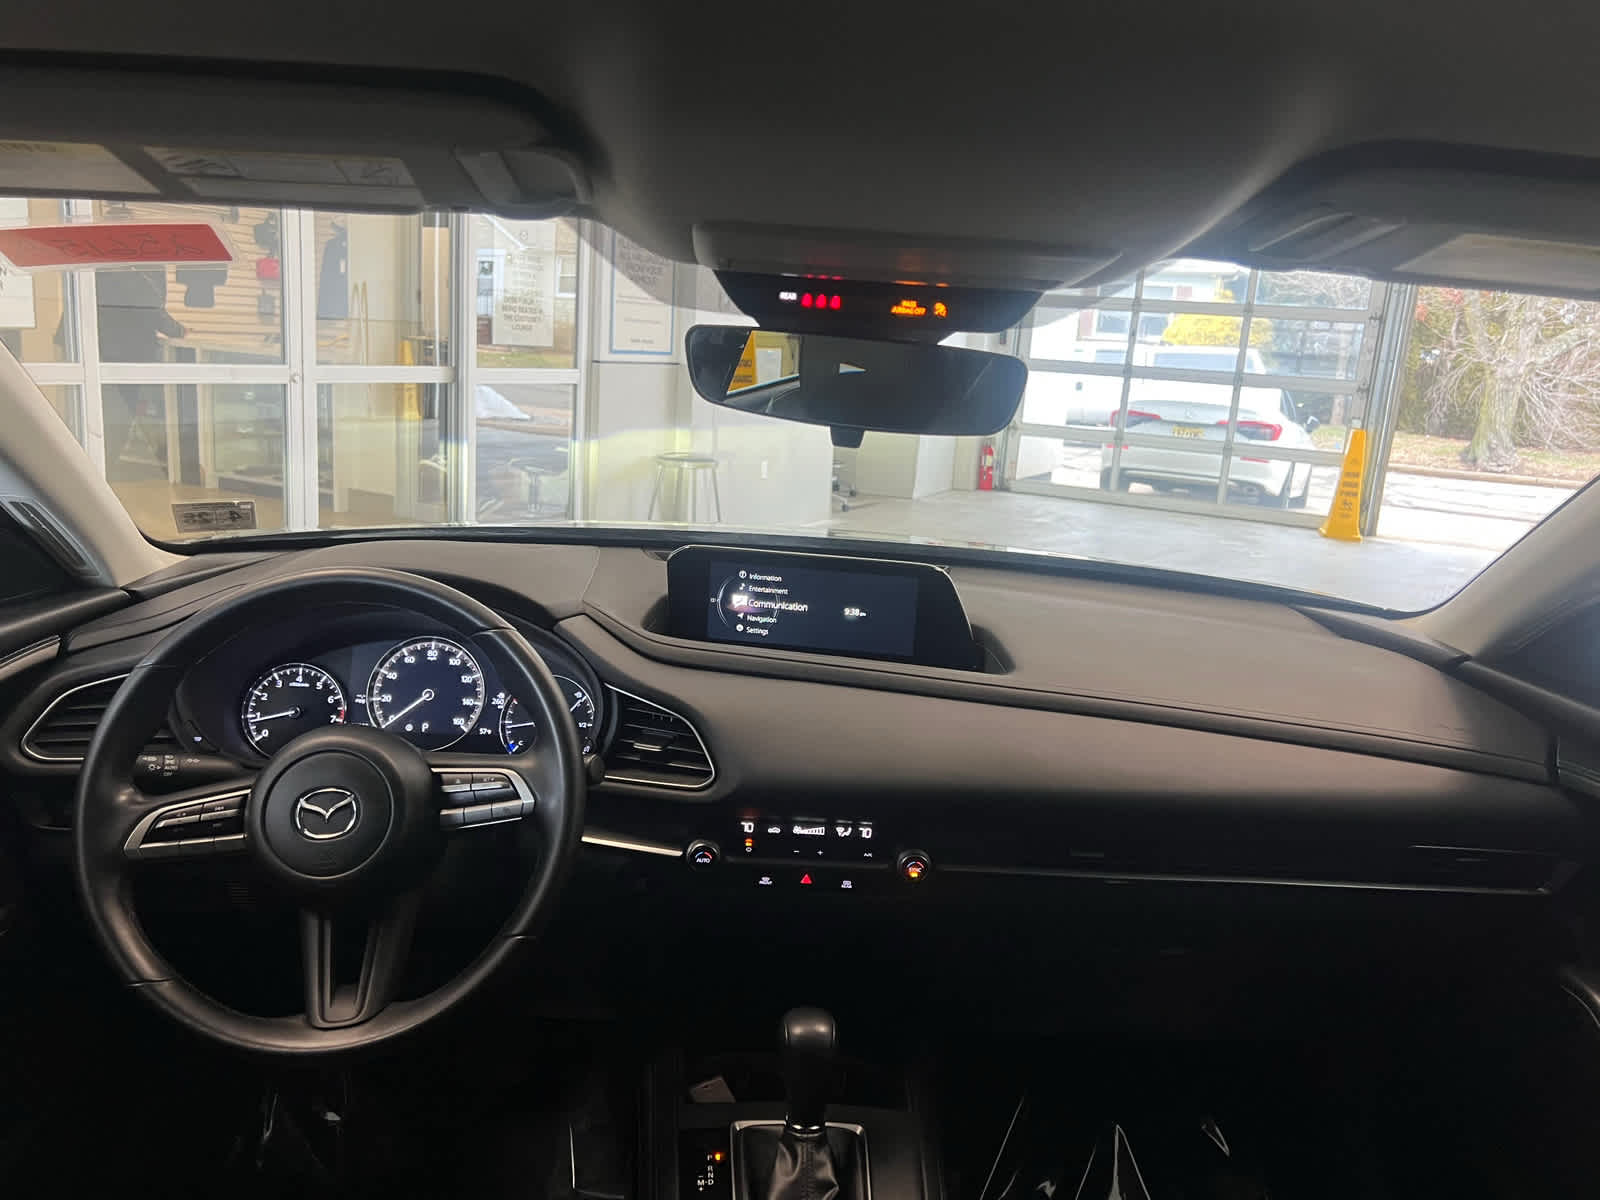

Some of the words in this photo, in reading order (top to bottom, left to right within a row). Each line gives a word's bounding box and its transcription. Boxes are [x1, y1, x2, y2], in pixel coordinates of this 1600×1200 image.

[749, 573, 782, 583] Information
[748, 585, 789, 595] Entertainment
[748, 599, 808, 612] Communication
[747, 614, 777, 624] Navigation
[746, 626, 769, 636] Settings
[449, 658, 461, 666] 100
[386, 672, 397, 680] 40
[461, 675, 473, 683] 120
[275, 679, 283, 688] 3
[316, 681, 323, 690] 5
[261, 692, 268, 701] 2
[327, 695, 335, 704] 6
[381, 694, 392, 703] 20
[462, 698, 474, 706] 140
[330, 715, 337, 723] 7
[421, 723, 429, 732] P
[261, 729, 269, 737] 0
[741, 821, 754, 833] 70
[859, 827, 872, 839] 70
